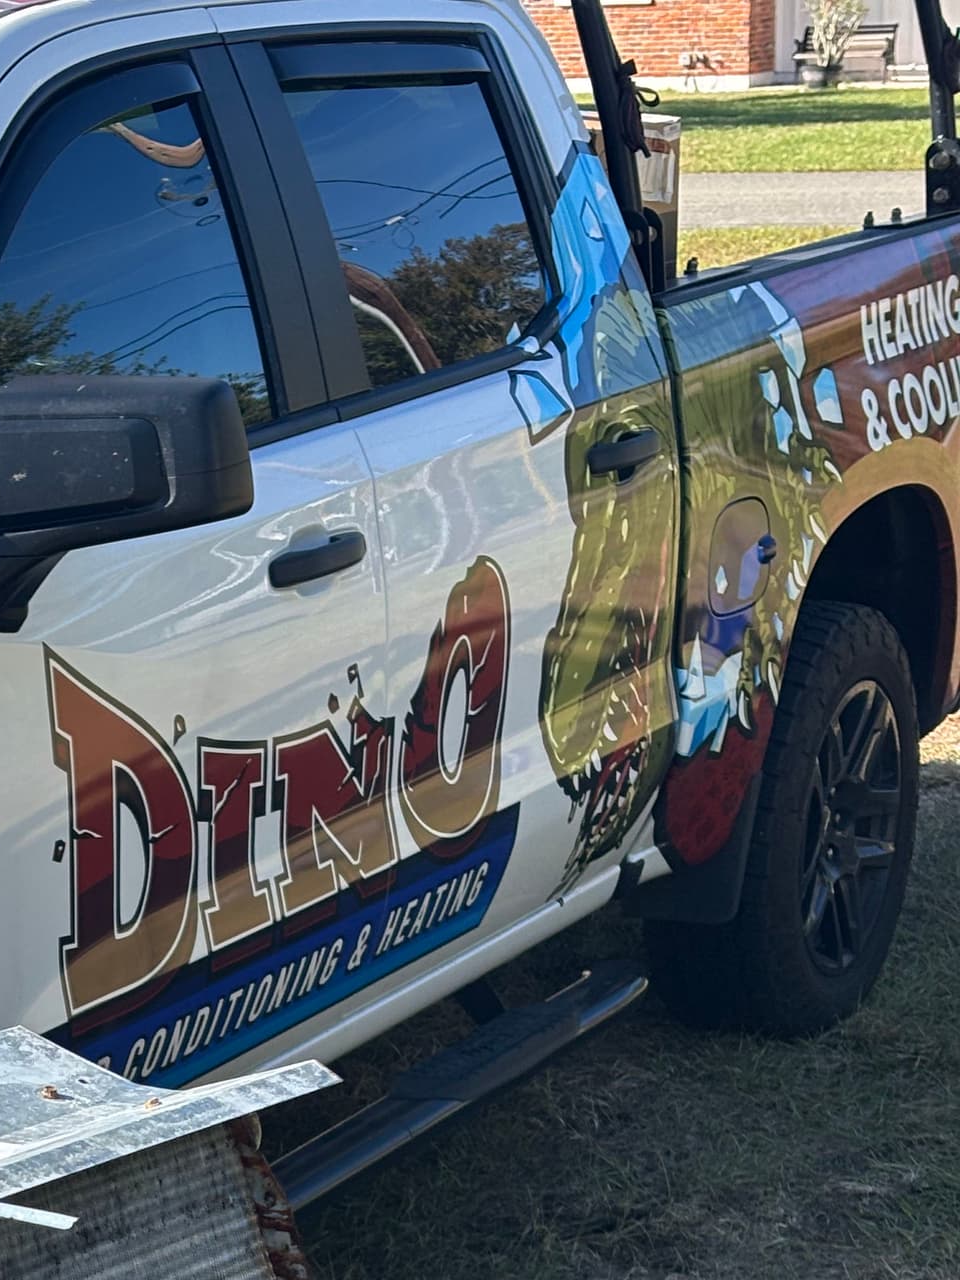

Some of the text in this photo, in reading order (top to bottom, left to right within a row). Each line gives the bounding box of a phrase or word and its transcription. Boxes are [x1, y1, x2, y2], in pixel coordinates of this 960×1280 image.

[861, 275, 960, 365] HEATING
[861, 355, 960, 451] & COOLI
[42, 555, 511, 1018] DINO
[123, 862, 489, 1080] CONDITIONING & HEATING
